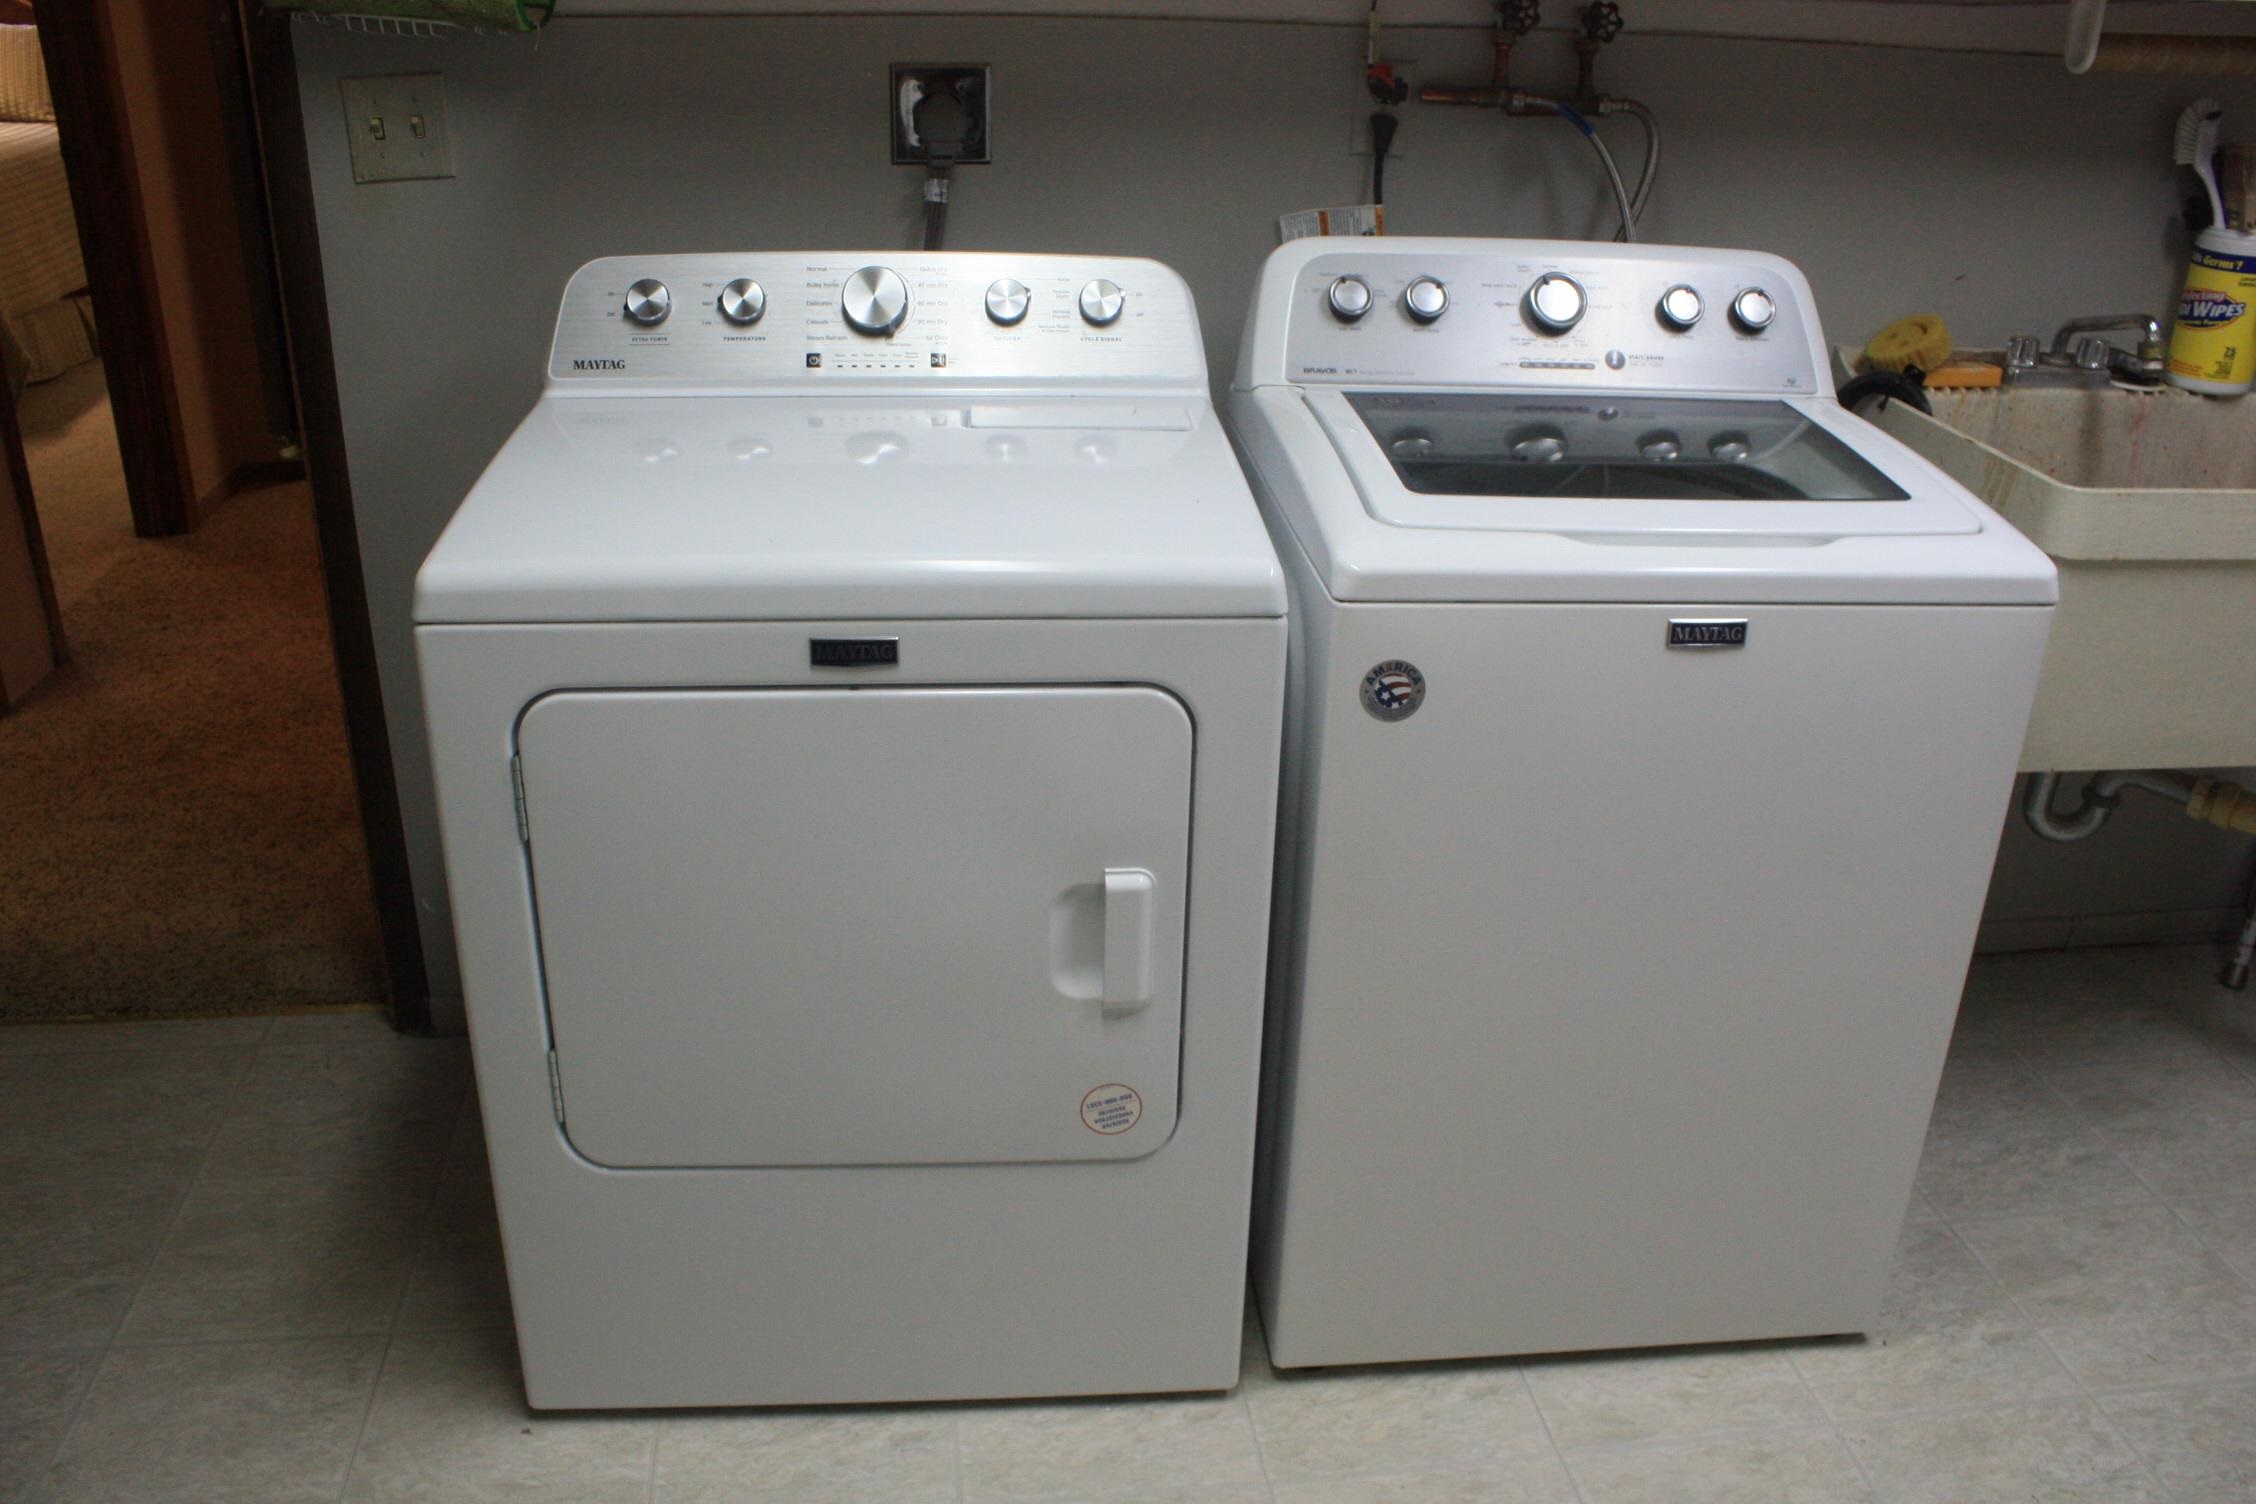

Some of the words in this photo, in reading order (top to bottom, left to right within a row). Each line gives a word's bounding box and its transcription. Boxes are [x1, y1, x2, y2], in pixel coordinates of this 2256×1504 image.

[2192, 301, 2246, 317] WIPES
[573, 359, 625, 370] MAYTAG
[1673, 626, 1743, 641] MAYTAG
[815, 644, 893, 660] MAYTAG
